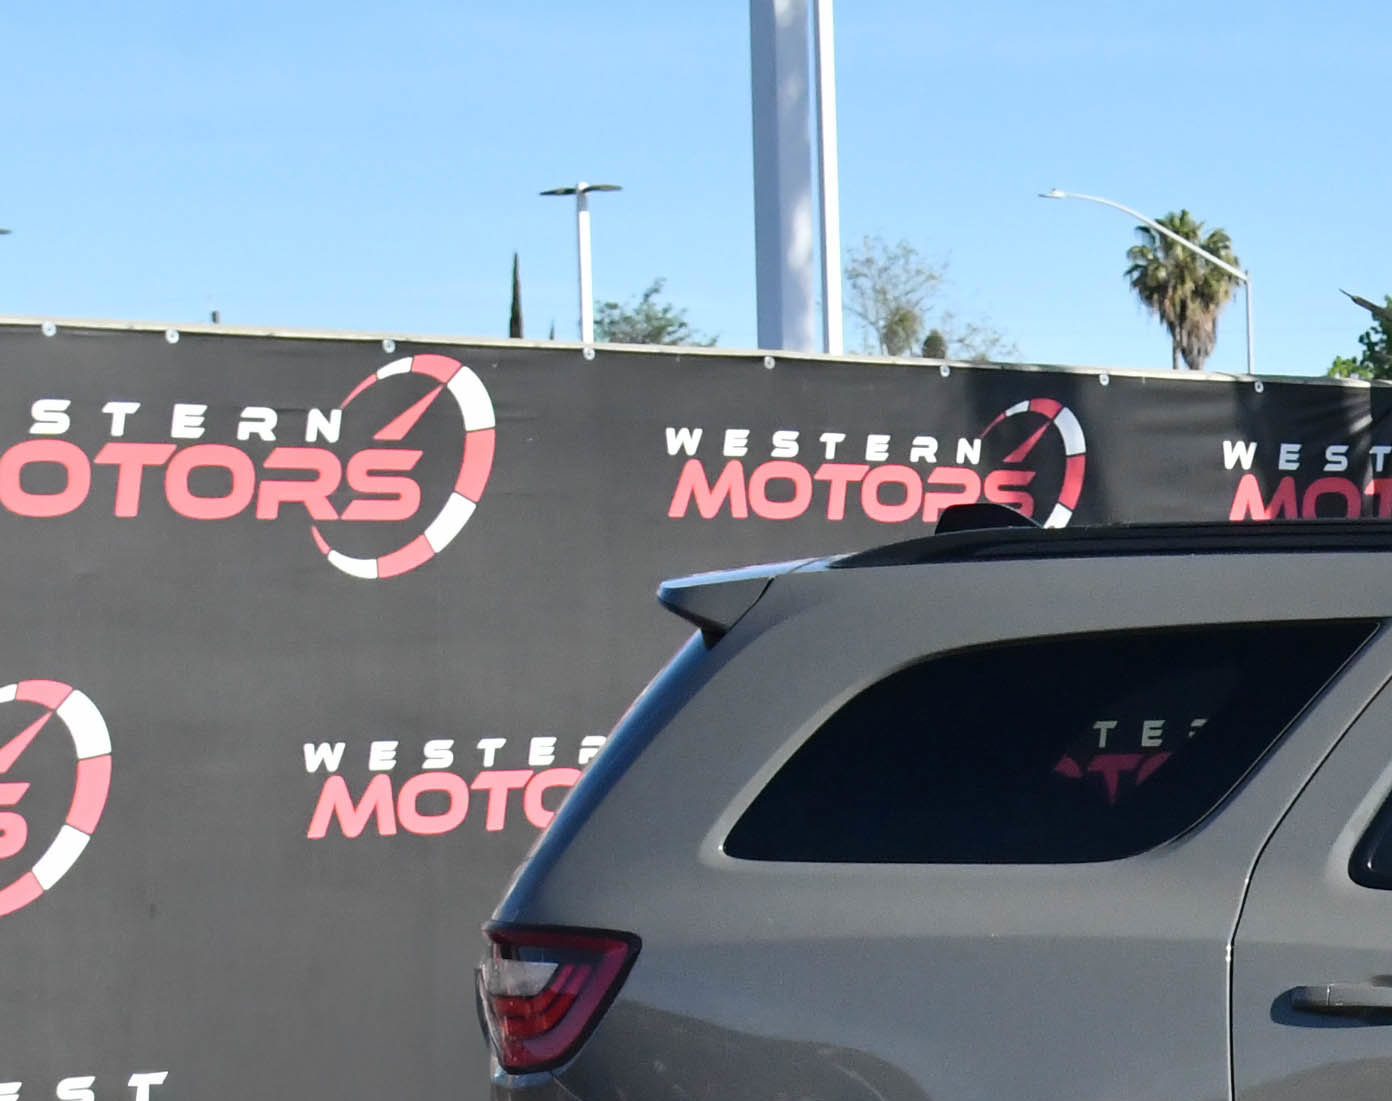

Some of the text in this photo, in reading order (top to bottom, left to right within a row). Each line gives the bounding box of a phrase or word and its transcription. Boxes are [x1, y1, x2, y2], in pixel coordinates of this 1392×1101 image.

[28, 398, 343, 443] STERN
[665, 427, 982, 465] WESTERN
[1222, 440, 1392, 472] WEST
[668, 458, 1036, 523] MOTORS
